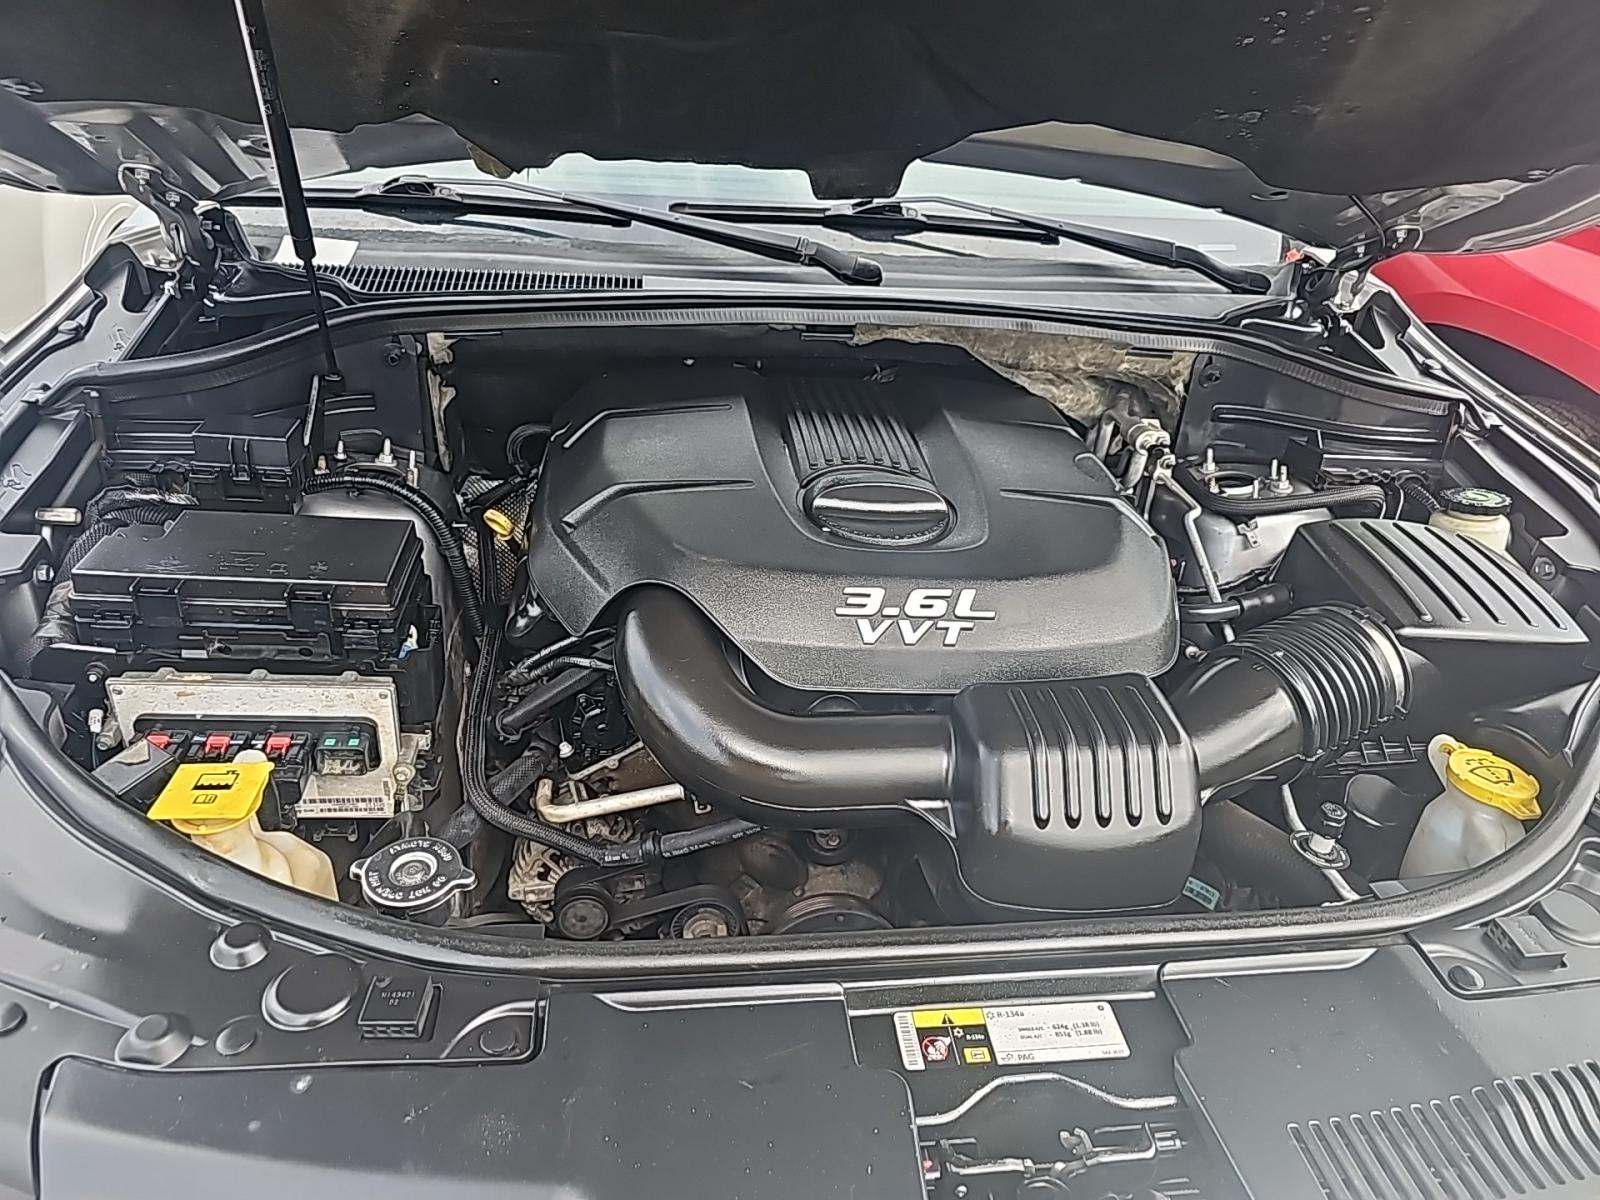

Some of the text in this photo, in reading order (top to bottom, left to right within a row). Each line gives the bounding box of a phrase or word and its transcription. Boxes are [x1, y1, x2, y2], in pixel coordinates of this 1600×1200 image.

[834, 586, 997, 620] 3.6L
[855, 618, 976, 647] VVT
[368, 871, 381, 887] HOT
[375, 887, 403, 900] OPEN
[408, 886, 432, 899] NOT
[996, 1010, 1025, 1019] R-134a
[1017, 1052, 1035, 1061] PAG
